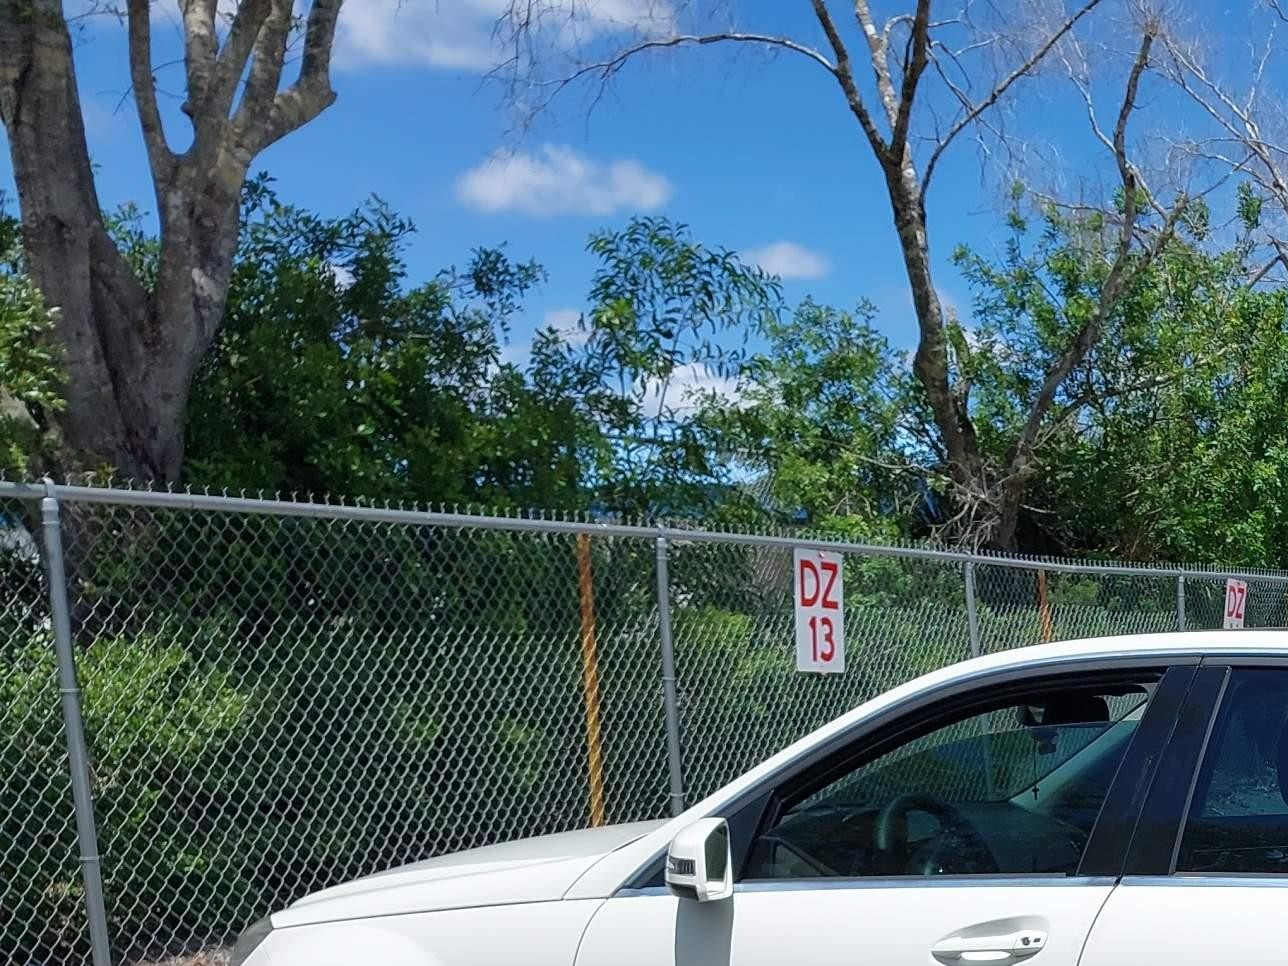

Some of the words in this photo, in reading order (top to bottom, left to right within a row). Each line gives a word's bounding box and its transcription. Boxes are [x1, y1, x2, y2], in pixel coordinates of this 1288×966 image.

[800, 559, 839, 610] DZ
[1227, 585, 1244, 619] DZ
[809, 615, 835, 662] 13
